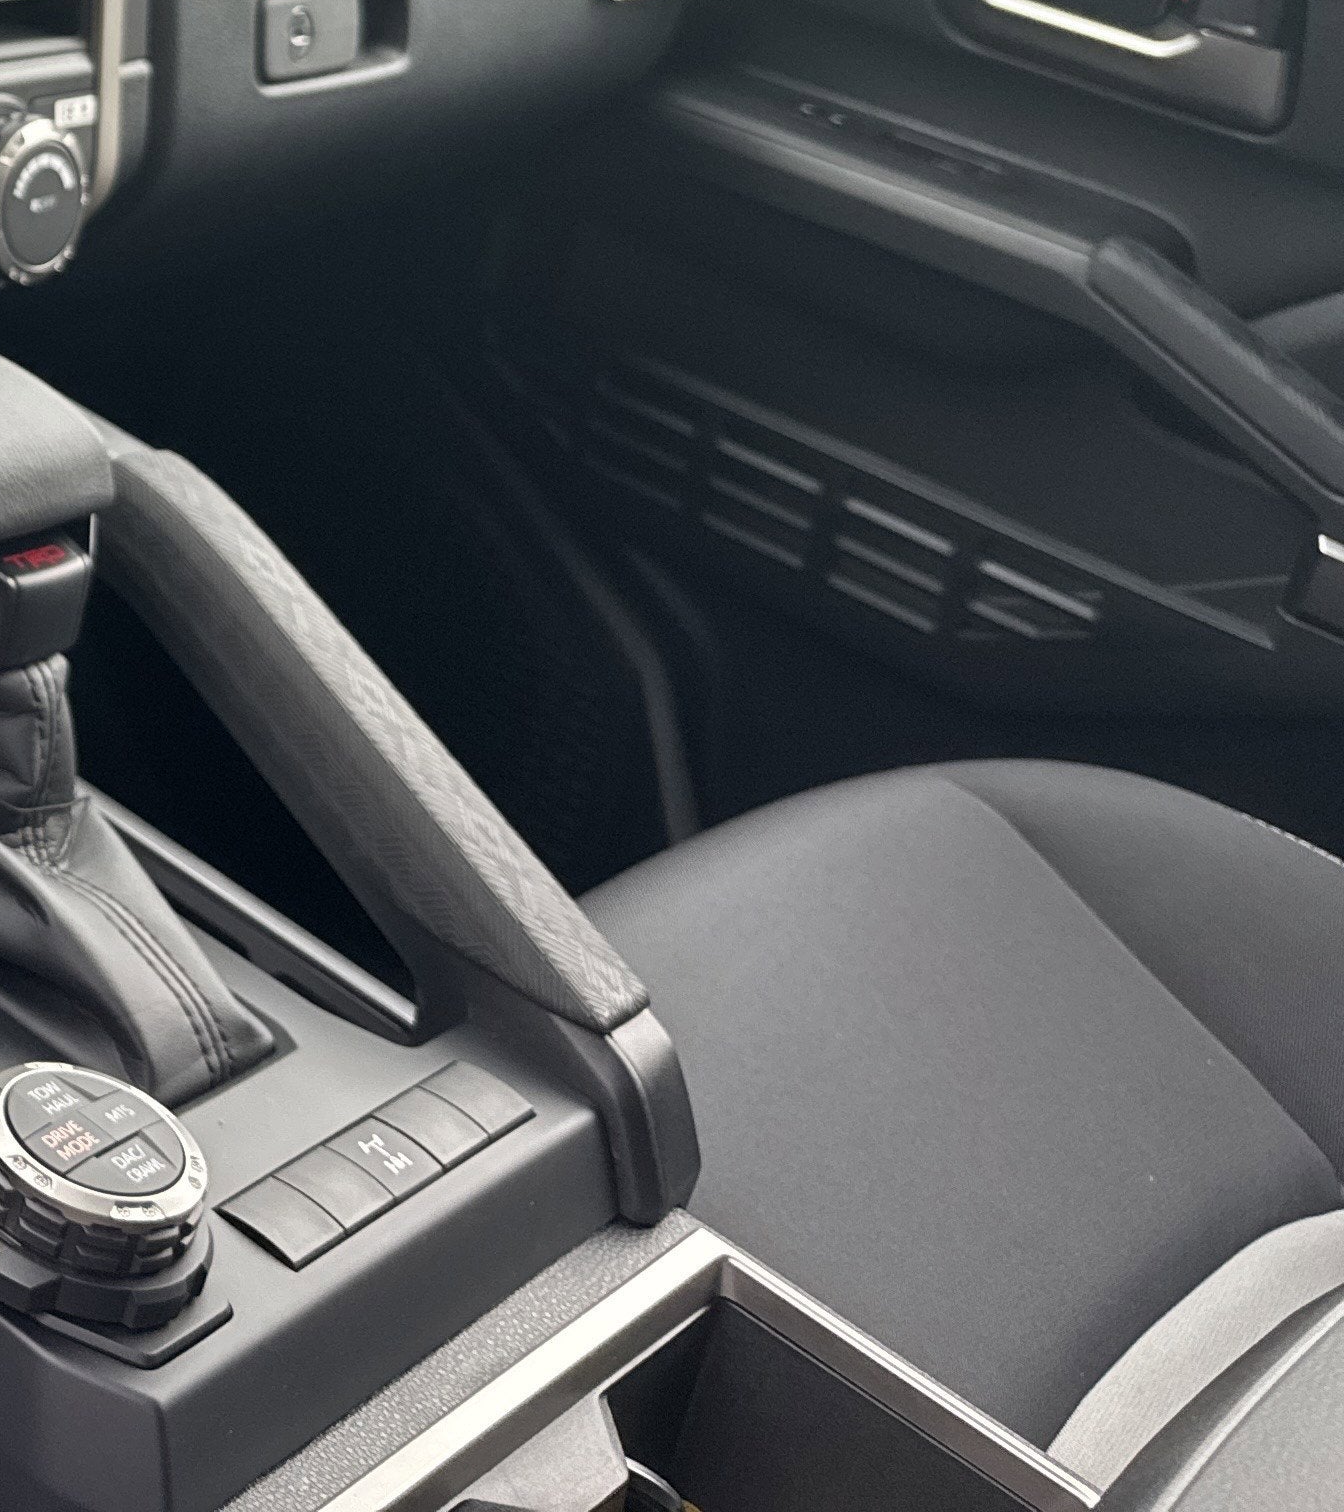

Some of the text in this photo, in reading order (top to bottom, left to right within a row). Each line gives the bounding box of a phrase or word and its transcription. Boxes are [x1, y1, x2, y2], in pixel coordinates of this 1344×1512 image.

[27, 1080, 62, 1101] TOW
[41, 1093, 80, 1116] HAUL
[104, 1104, 136, 1124] MTS
[41, 1119, 84, 1148] DRIVE
[56, 1131, 102, 1161] MODE
